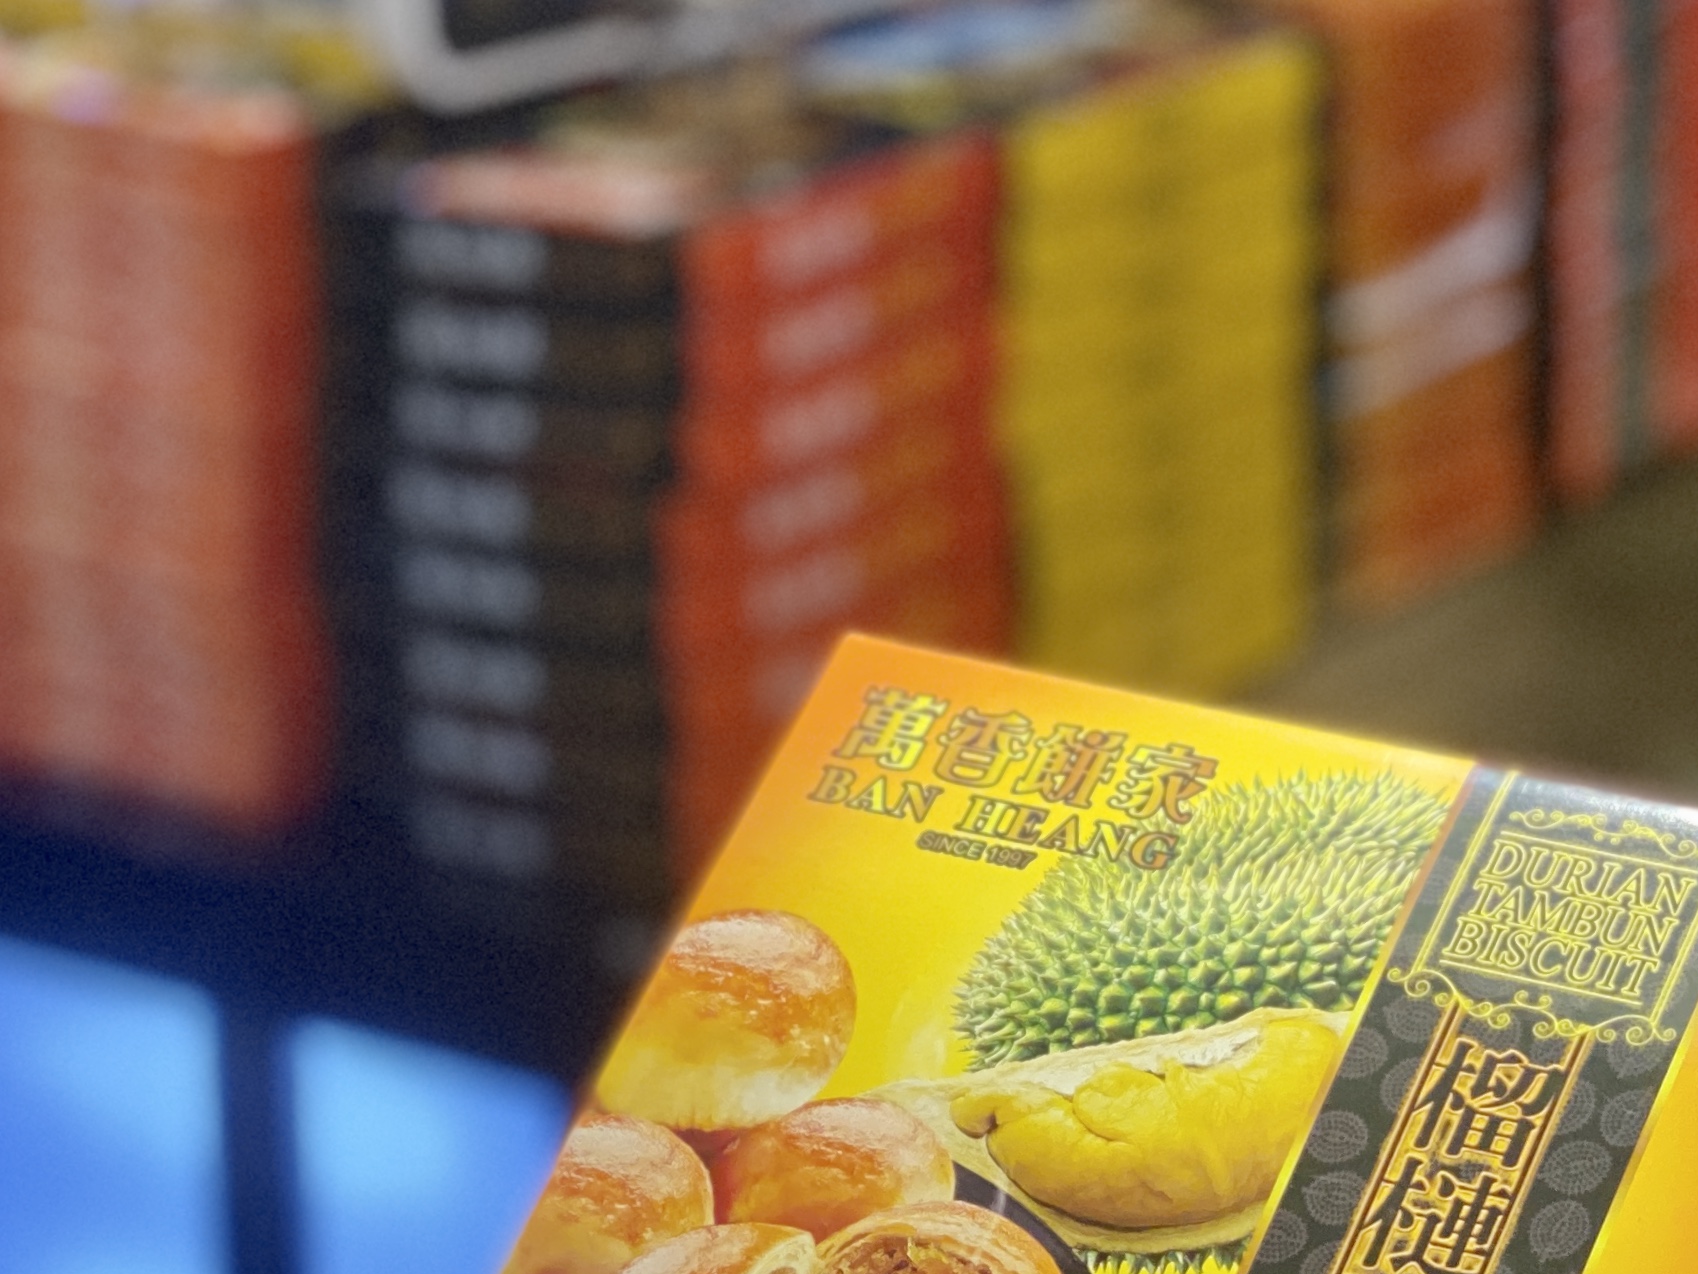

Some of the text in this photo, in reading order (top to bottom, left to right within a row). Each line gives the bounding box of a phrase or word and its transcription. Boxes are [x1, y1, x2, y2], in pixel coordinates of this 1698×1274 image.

[833, 685, 1219, 824] 萬香餅家
[807, 765, 1181, 871] BAN HEANG
[917, 830, 1038, 870] SINCE 1997
[1483, 838, 1697, 916] DURIAN
[1443, 917, 1660, 997] BISCUIT
[1469, 878, 1679, 957] TAMBUN
